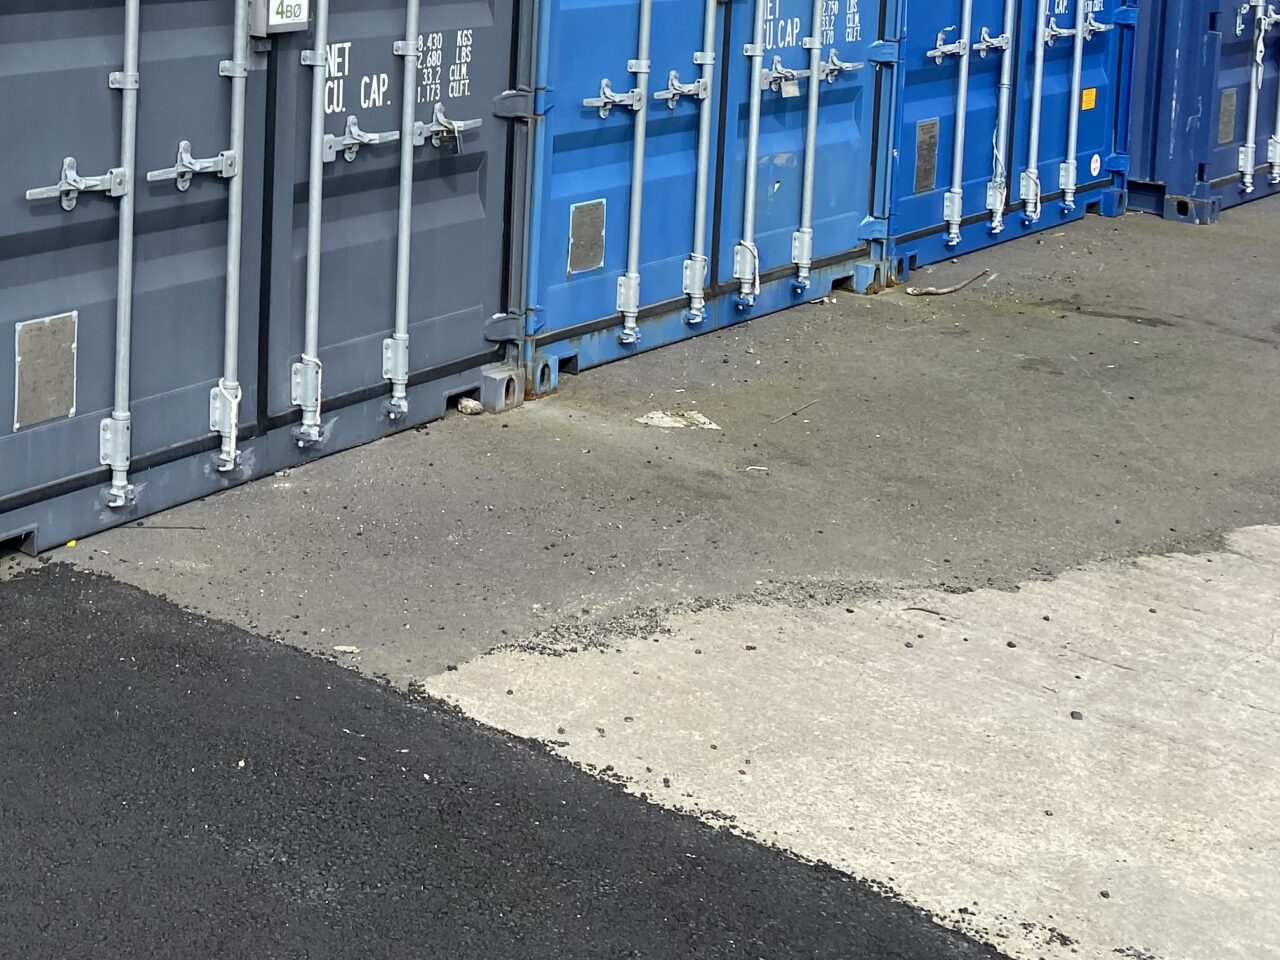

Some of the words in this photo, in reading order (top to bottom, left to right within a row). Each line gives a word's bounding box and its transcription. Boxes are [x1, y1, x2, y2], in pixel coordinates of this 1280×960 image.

[456, 29, 473, 47] KGS
[325, 42, 352, 78] NET
[455, 46, 472, 64] LBS
[422, 66, 441, 85] 33.2
[324, 79, 346, 114] CU.
[360, 73, 391, 109] CAP.
